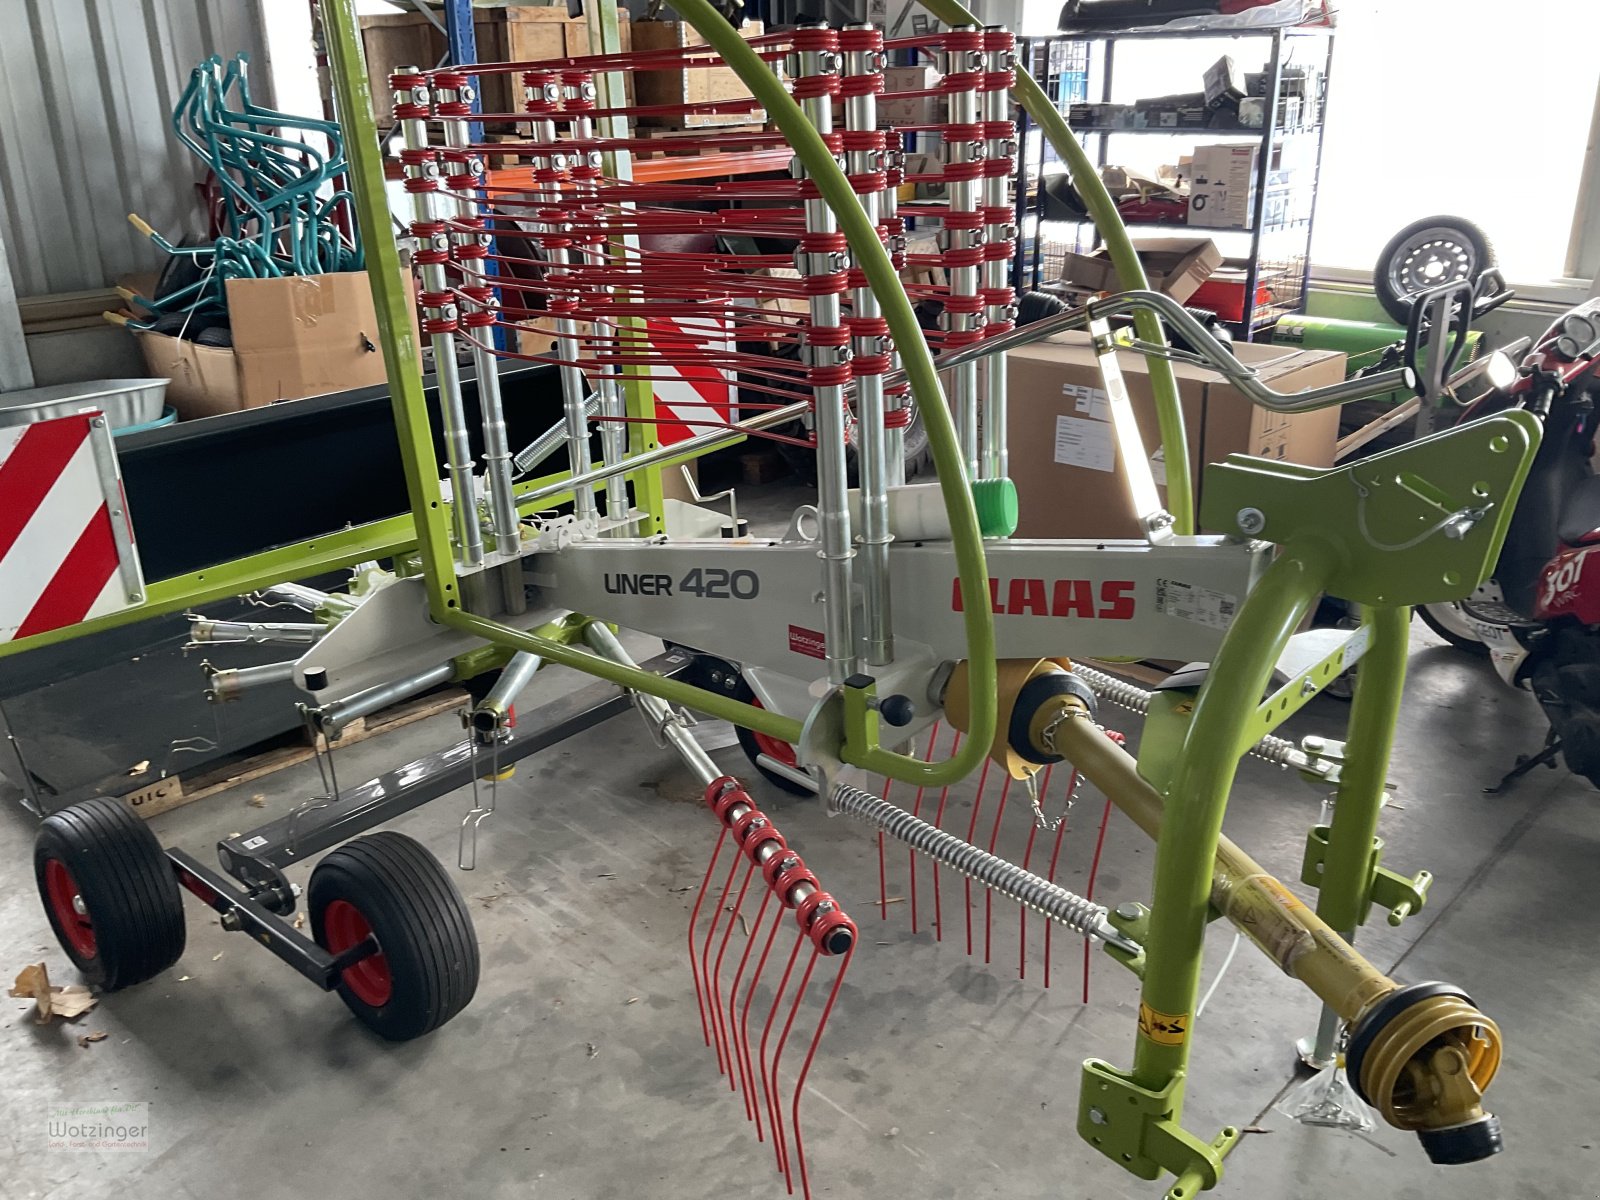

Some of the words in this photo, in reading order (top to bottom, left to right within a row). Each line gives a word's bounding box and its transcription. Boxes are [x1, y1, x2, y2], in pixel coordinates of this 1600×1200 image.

[604, 573, 673, 596] LINER
[679, 567, 760, 600] 420
[789, 631, 826, 650] Wotzinge
